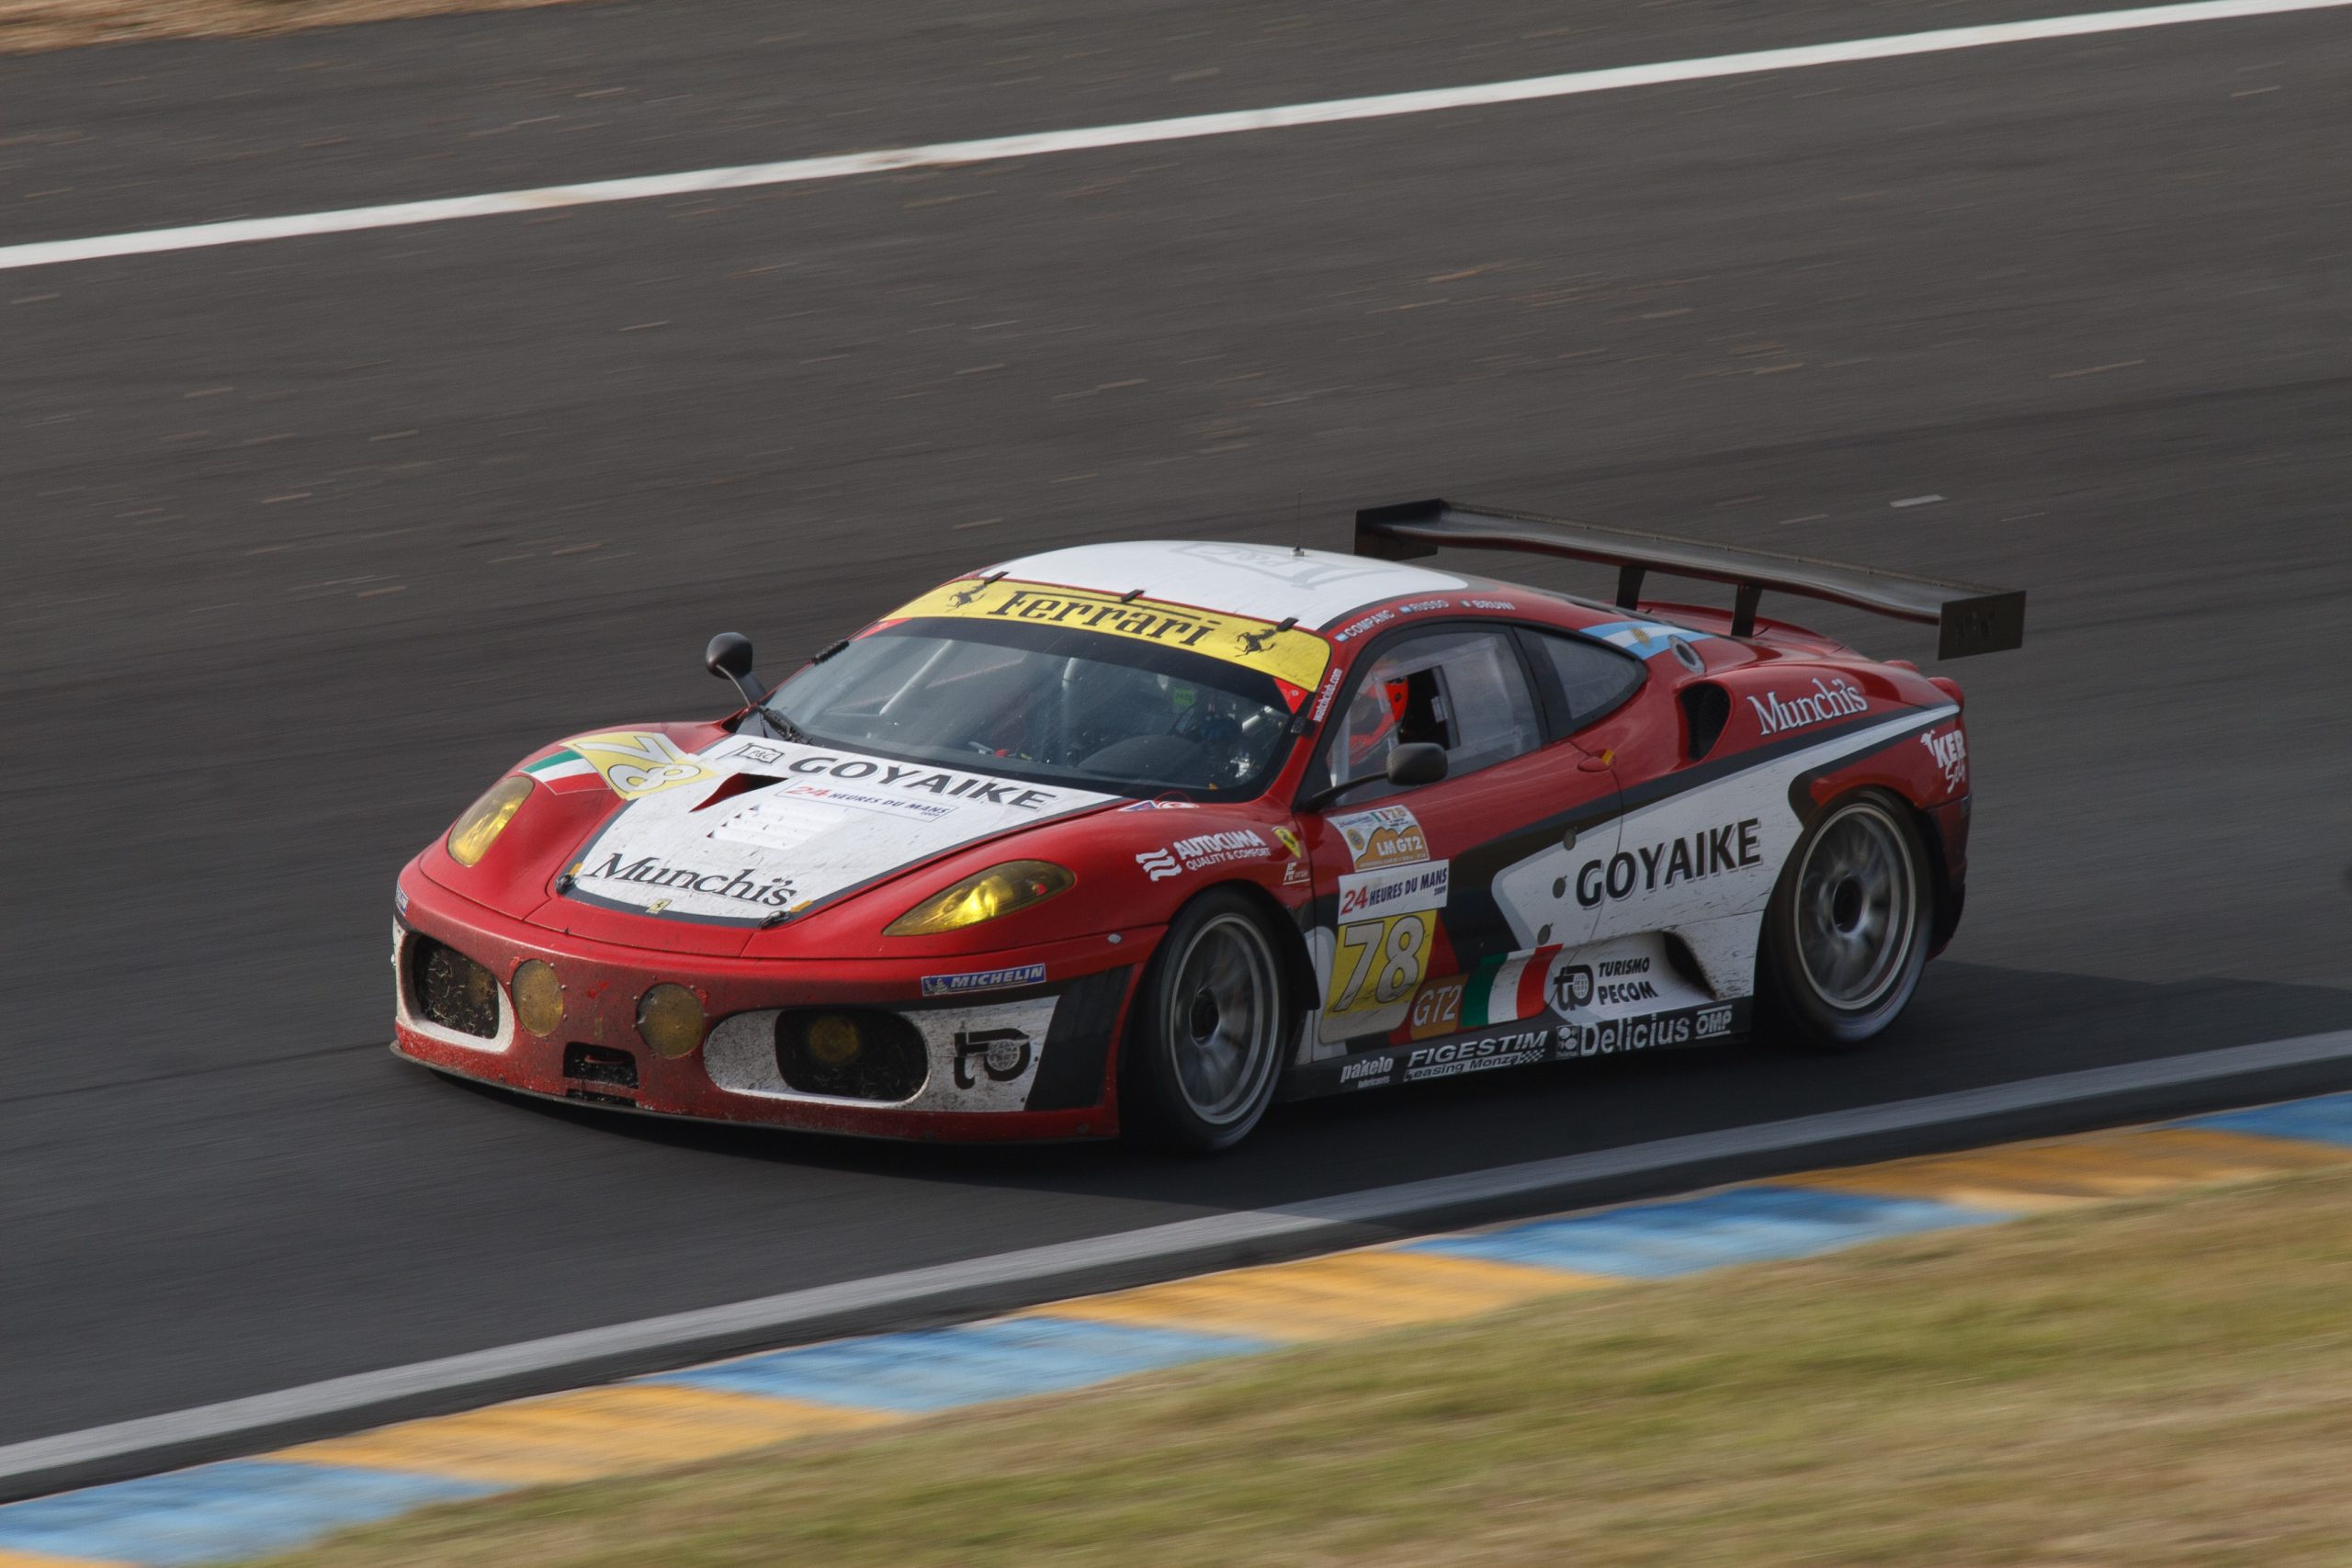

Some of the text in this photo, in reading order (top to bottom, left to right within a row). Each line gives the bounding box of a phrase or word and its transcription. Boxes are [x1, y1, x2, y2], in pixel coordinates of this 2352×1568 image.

[987, 591, 1222, 647] Ferrari
[1409, 600, 1450, 612] RUSSO
[1472, 600, 1516, 611] BRUNI
[788, 757, 1057, 809] GOYAIKE
[787, 786, 951, 815] 24 HEURES DU MANS
[1173, 829, 1266, 861] AUTOCLIMA
[1185, 847, 1272, 871] QUALITY & COMFORT
[1376, 836, 1423, 856] LM GT2
[1576, 818, 1763, 910] GOYAIKE
[1340, 868, 1448, 916] 24 HEURES DU MANS
[1433, 886, 1447, 897] 2009
[951, 966, 1044, 988] MICHELIN
[1333, 915, 1425, 1013] 78
[1598, 957, 1650, 978] TURISMO
[1412, 985, 1463, 1027] GT2
[1598, 981, 1659, 1005] PECOM
[1581, 1013, 1690, 1056] Delicius
[1696, 1009, 1733, 1036] OMP
[1408, 1031, 1548, 1067] FIGESTIM
[1403, 1063, 1464, 1082] Leasing
